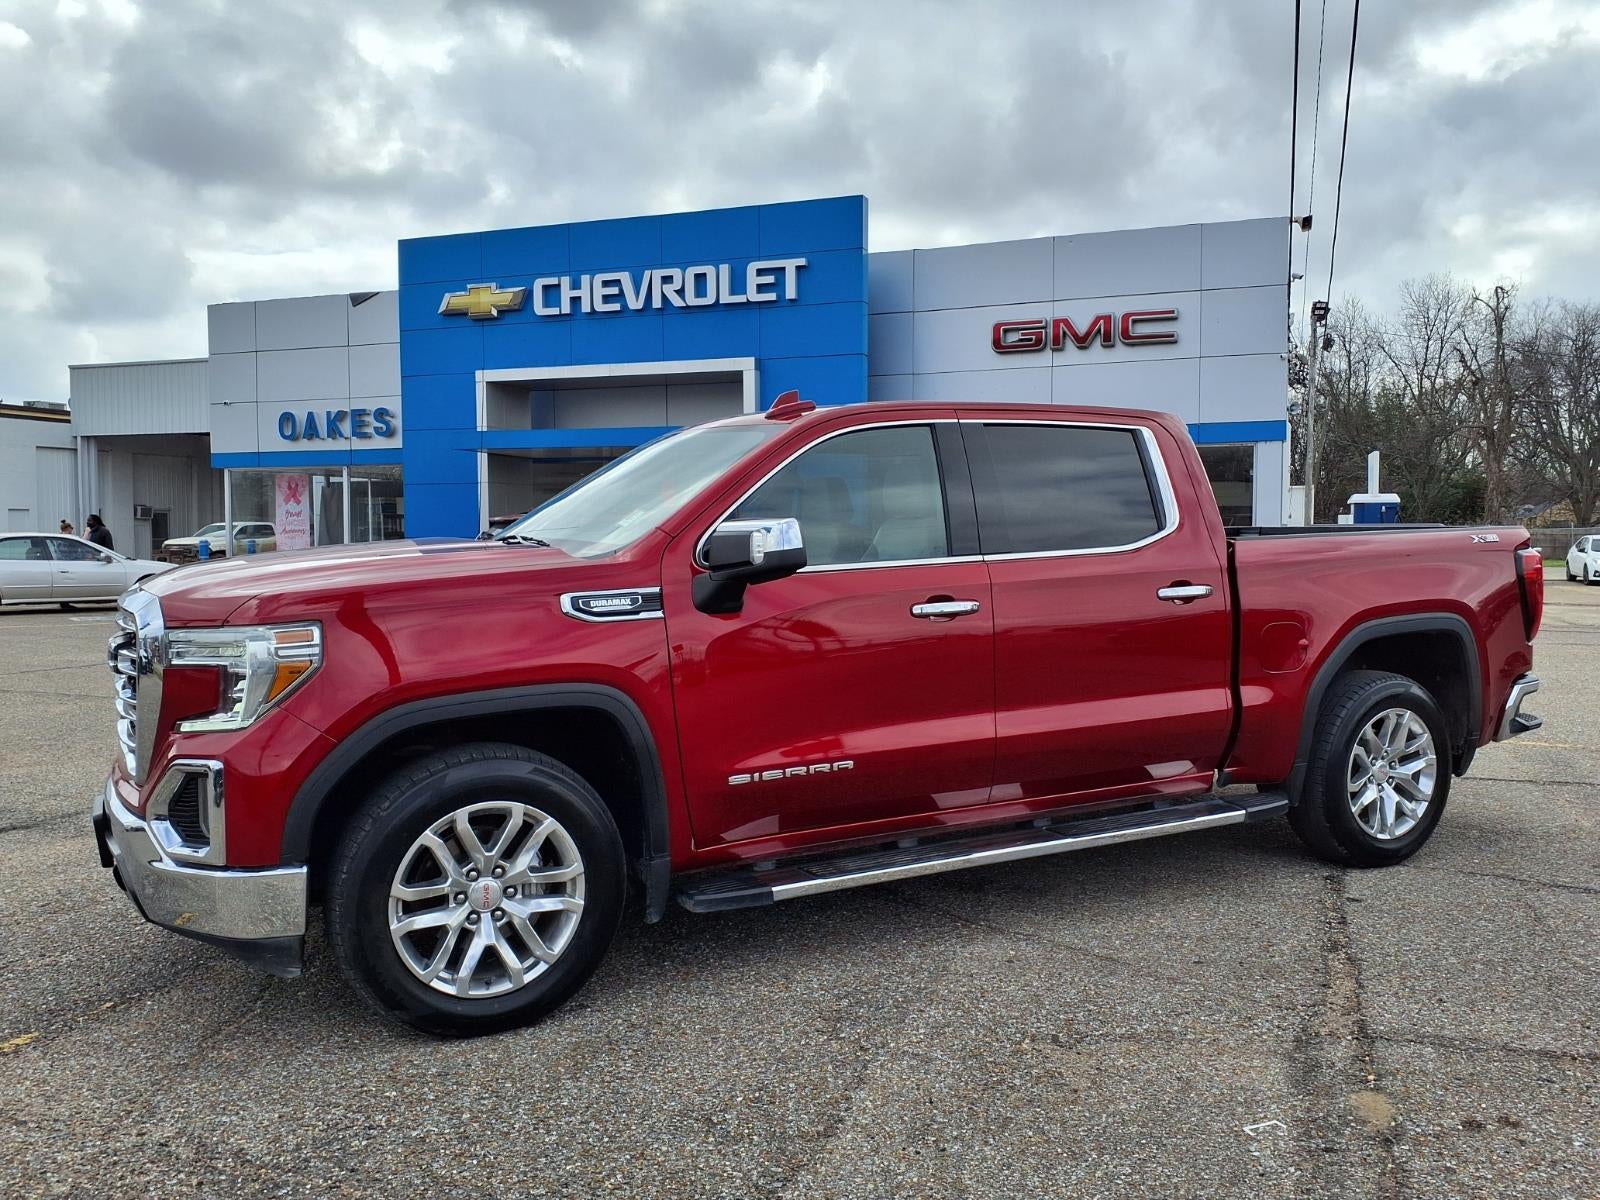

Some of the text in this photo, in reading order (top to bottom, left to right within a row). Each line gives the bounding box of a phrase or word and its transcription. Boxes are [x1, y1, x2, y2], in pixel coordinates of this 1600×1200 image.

[533, 257, 808, 317] CHEVROLET
[991, 307, 1180, 354] GMC
[278, 407, 395, 441] OAKES
[589, 598, 632, 608] DURAMAX
[728, 760, 854, 785] SIERRA
